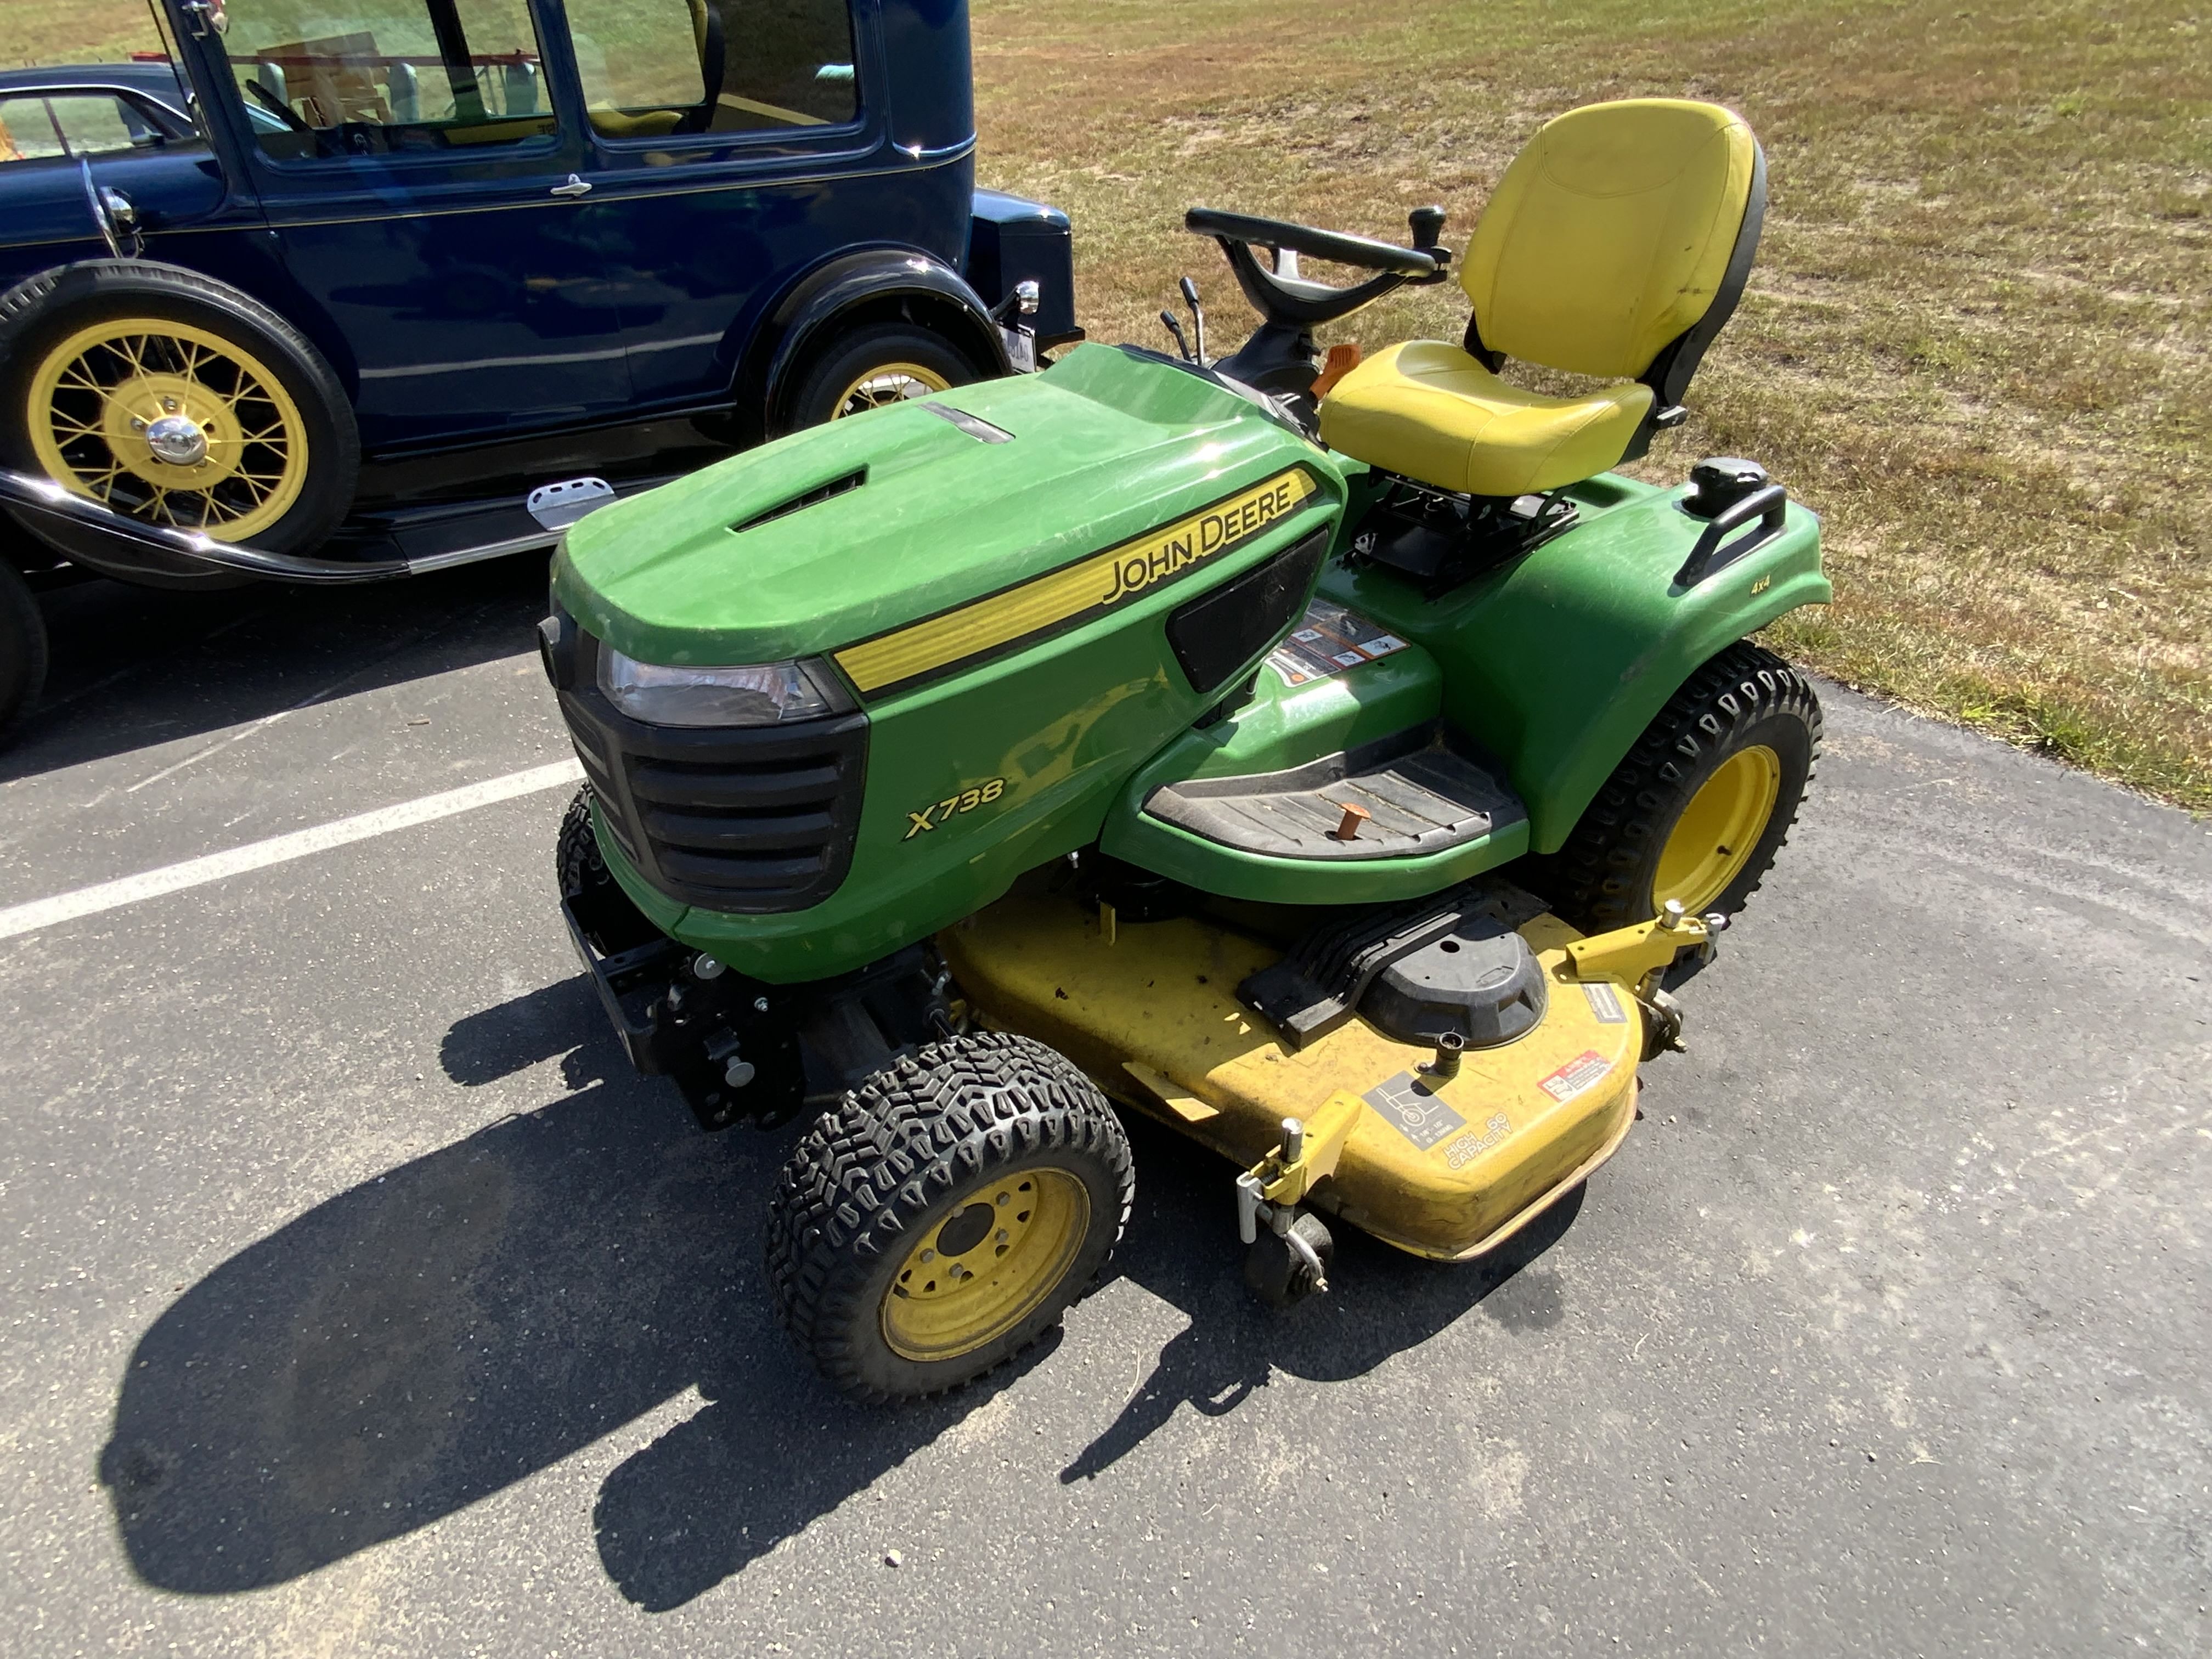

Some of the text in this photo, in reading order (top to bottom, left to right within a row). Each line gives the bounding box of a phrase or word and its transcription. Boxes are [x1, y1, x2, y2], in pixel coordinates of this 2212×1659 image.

[1103, 482, 1291, 601] JOHN DEERE
[903, 778, 1005, 840] X738
[1443, 1131, 1477, 1159] HIGH
[1486, 1111, 1508, 1130] 60
[1447, 1121, 1513, 1170] CAPACITY
